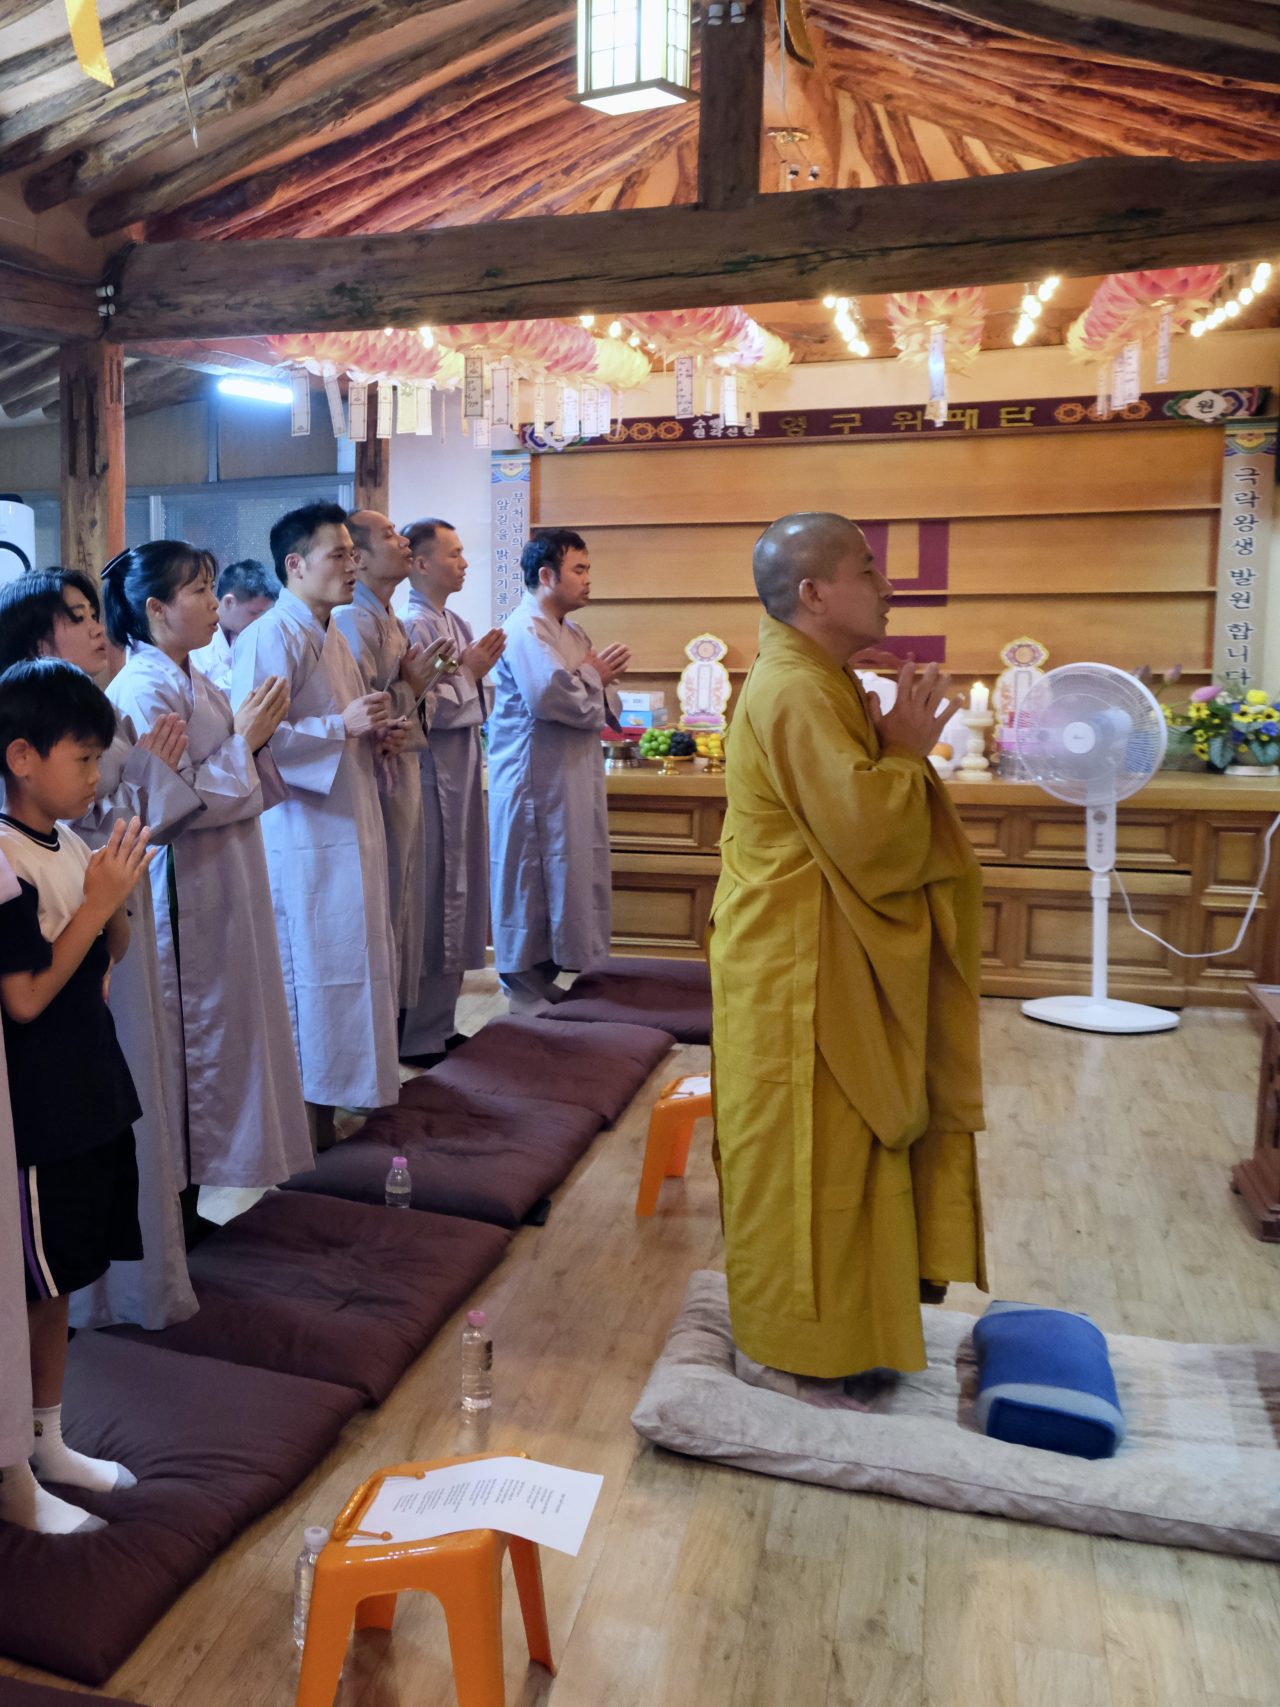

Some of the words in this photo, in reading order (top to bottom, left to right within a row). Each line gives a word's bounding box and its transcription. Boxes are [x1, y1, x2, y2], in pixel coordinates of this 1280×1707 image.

[512, 492, 524, 548] 부처님의
[1233, 467, 1262, 557] 극락왕생
[1229, 567, 1256, 610] 발원
[1225, 621, 1254, 686] 합니다
